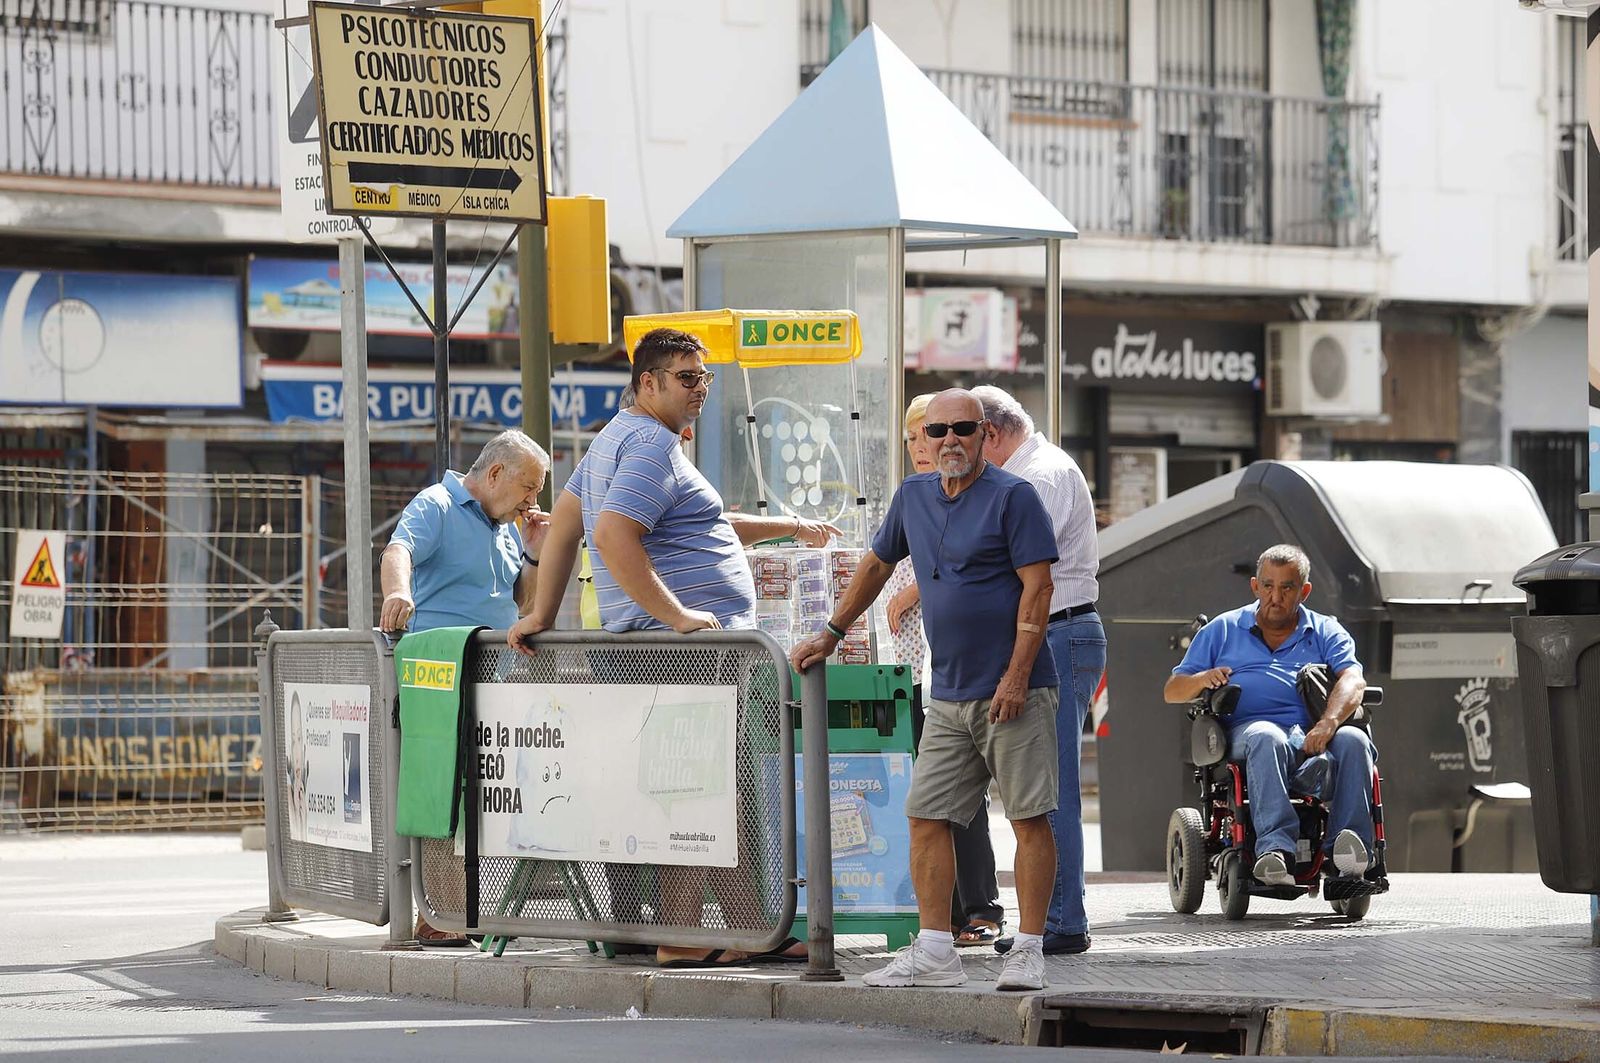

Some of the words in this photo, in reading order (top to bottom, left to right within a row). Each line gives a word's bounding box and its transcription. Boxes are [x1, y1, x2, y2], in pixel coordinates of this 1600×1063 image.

[340, 13, 506, 54] PSICOTECNICOS
[354, 50, 501, 88] CONDUCTORES
[358, 86, 490, 122] CAZADORES
[329, 121, 454, 156] CERTIFICADOS
[461, 126, 534, 161] MÉDICOS
[355, 189, 391, 205] CENTRO
[408, 189, 441, 207] MÉDICO
[463, 195, 482, 209] ISLA
[483, 196, 510, 210] CHICA
[308, 216, 372, 235] CONTROLAO
[773, 322, 842, 342] ONCE
[313, 384, 382, 418] BR
[501, 387, 586, 419] CNA
[16, 593, 62, 609] PELIGRO
[23, 609, 53, 622] OBRA
[417, 665, 453, 684] ONCE
[475, 720, 492, 747] de
[496, 721, 510, 747] la
[514, 722, 565, 748] noche.
[483, 786, 523, 814] HORA
